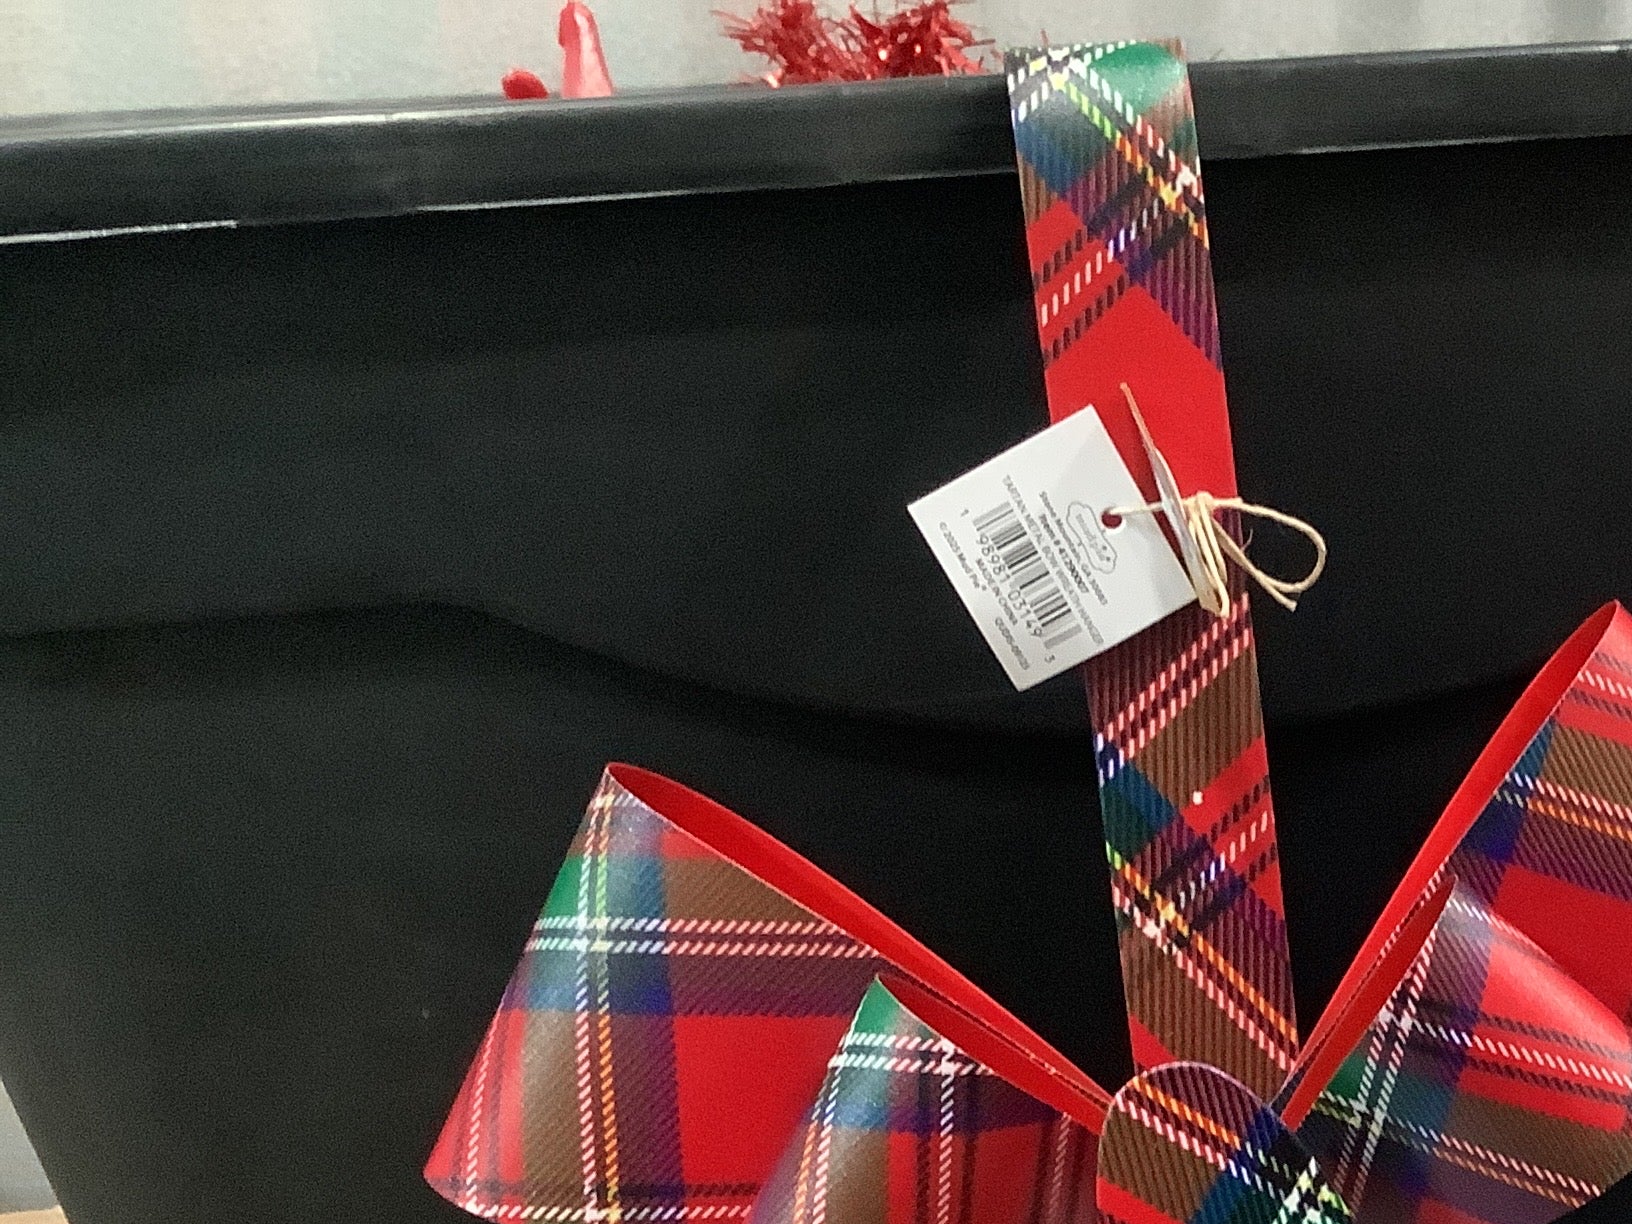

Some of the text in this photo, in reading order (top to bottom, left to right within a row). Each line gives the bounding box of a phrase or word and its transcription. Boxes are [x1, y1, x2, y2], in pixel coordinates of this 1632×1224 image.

[1038, 514, 1056, 539] Item
[1039, 491, 1057, 517] Stone
[957, 553, 972, 573] Mud
[1001, 475, 1103, 645] TARTAN METAL BOW WREATH HANGER
[975, 534, 1010, 583] 98981
[1007, 588, 1043, 639] 03149
[976, 558, 994, 584] MADE
[998, 596, 1017, 624] CHINA
